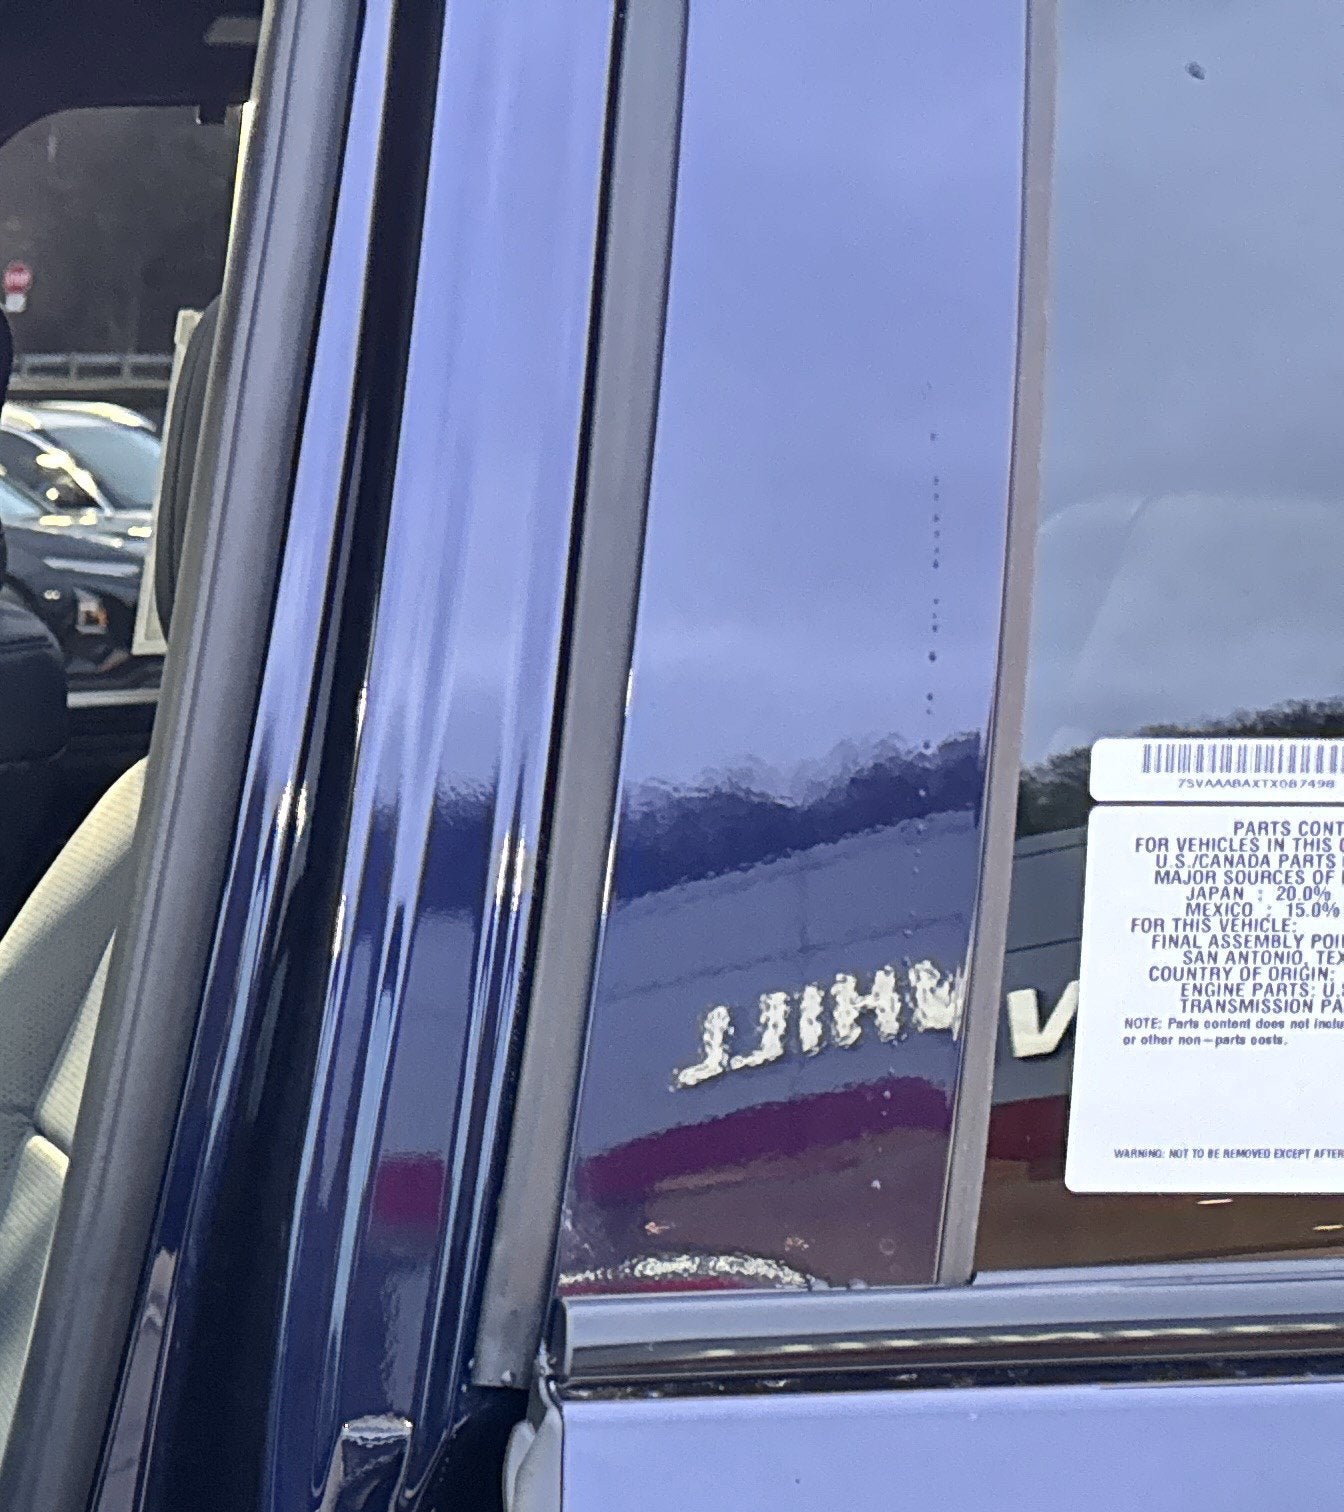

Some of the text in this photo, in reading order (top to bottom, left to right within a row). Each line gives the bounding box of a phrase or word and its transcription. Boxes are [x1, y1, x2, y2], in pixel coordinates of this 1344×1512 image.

[1234, 820, 1291, 836] PARTS
[1136, 837, 1169, 853] FOR
[1176, 837, 1259, 853] VEHICLES
[1268, 837, 1284, 852] IN
[1292, 837, 1332, 852] THIS
[1156, 853, 1270, 869] U.S./CANADA
[1279, 853, 1336, 869] PARTS
[1155, 870, 1216, 885] MAJOR
[1224, 870, 1305, 885] SOURCES
[1313, 870, 1335, 885] OF
[1186, 886, 1244, 901] JAPAN
[1276, 886, 1331, 901] 20.0%
[1186, 902, 1252, 918] MEXICO
[1286, 902, 1340, 918] 15.0%
[1131, 918, 1296, 933] FOR THIS VEHICLE:
[1152, 934, 1202, 949] FINAL
[1208, 934, 1304, 949] ASSEMBLY
[1183, 950, 1218, 965] SAN
[1225, 950, 1308, 967] ANTONIO,
[1149, 966, 1334, 982] COUNTRY OF ORIGIN:
[1181, 983, 1245, 998] ENGINE
[1252, 983, 1315, 998] PARTS:
[1180, 999, 1313, 1014] TRANSMISSION
[1125, 1017, 1162, 1029] NOTE:
[1168, 1018, 1199, 1029] Parts
[1204, 1018, 1250, 1029] content
[1256, 1018, 1284, 1029] does
[1290, 1018, 1309, 1029] not
[1123, 1036, 1136, 1045] or
[1141, 1035, 1173, 1045] other
[1251, 1035, 1287, 1045] costs.
[1169, 1149, 1188, 1158] NOT
[1192, 1149, 1204, 1158] TO
[1208, 1149, 1219, 1159] BE
[1223, 1149, 1271, 1158] REMOVED
[1274, 1149, 1310, 1159] EXCEPT
